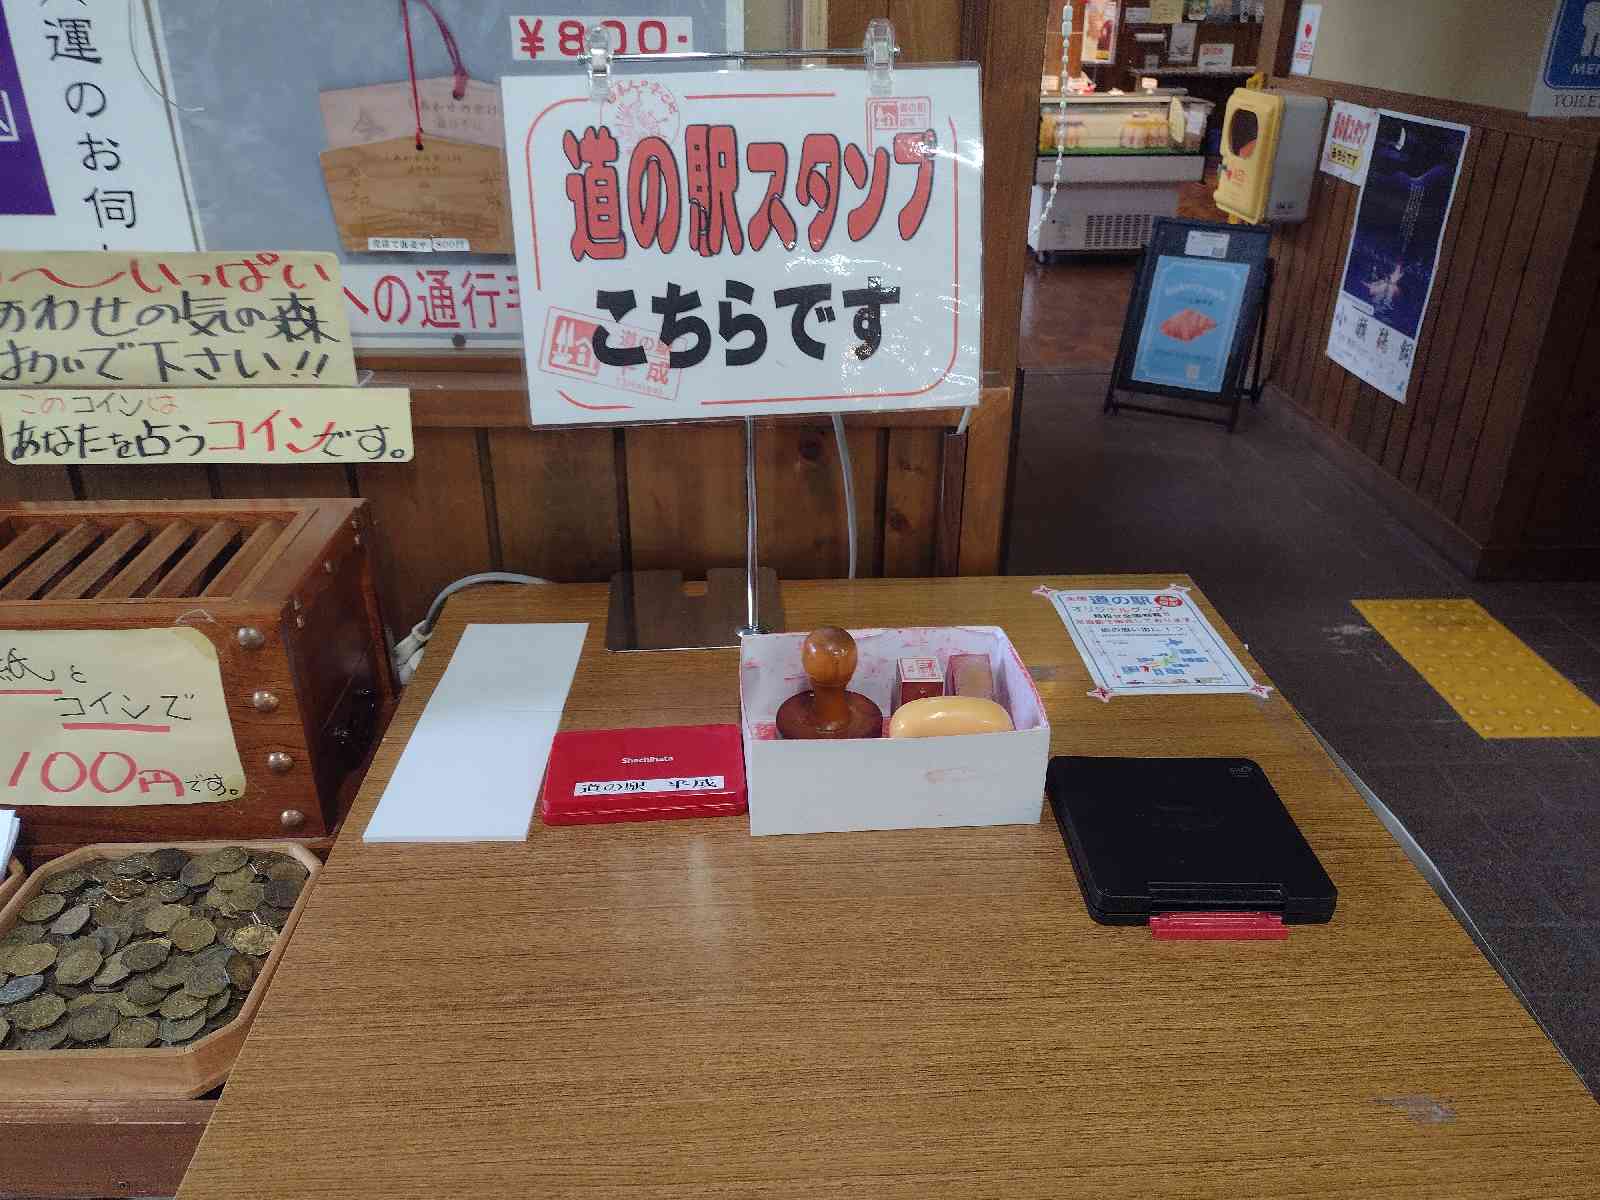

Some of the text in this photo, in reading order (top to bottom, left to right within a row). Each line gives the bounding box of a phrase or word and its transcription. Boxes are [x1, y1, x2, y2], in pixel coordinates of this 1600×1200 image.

[38, 0, 137, 250] 運のお伺
[1552, 94, 1600, 108] TOILE
[562, 124, 937, 262] 道の駅スタンプ
[592, 276, 901, 369] こちらです
[19, 392, 178, 417] このコインは
[53, 691, 194, 720] コインで
